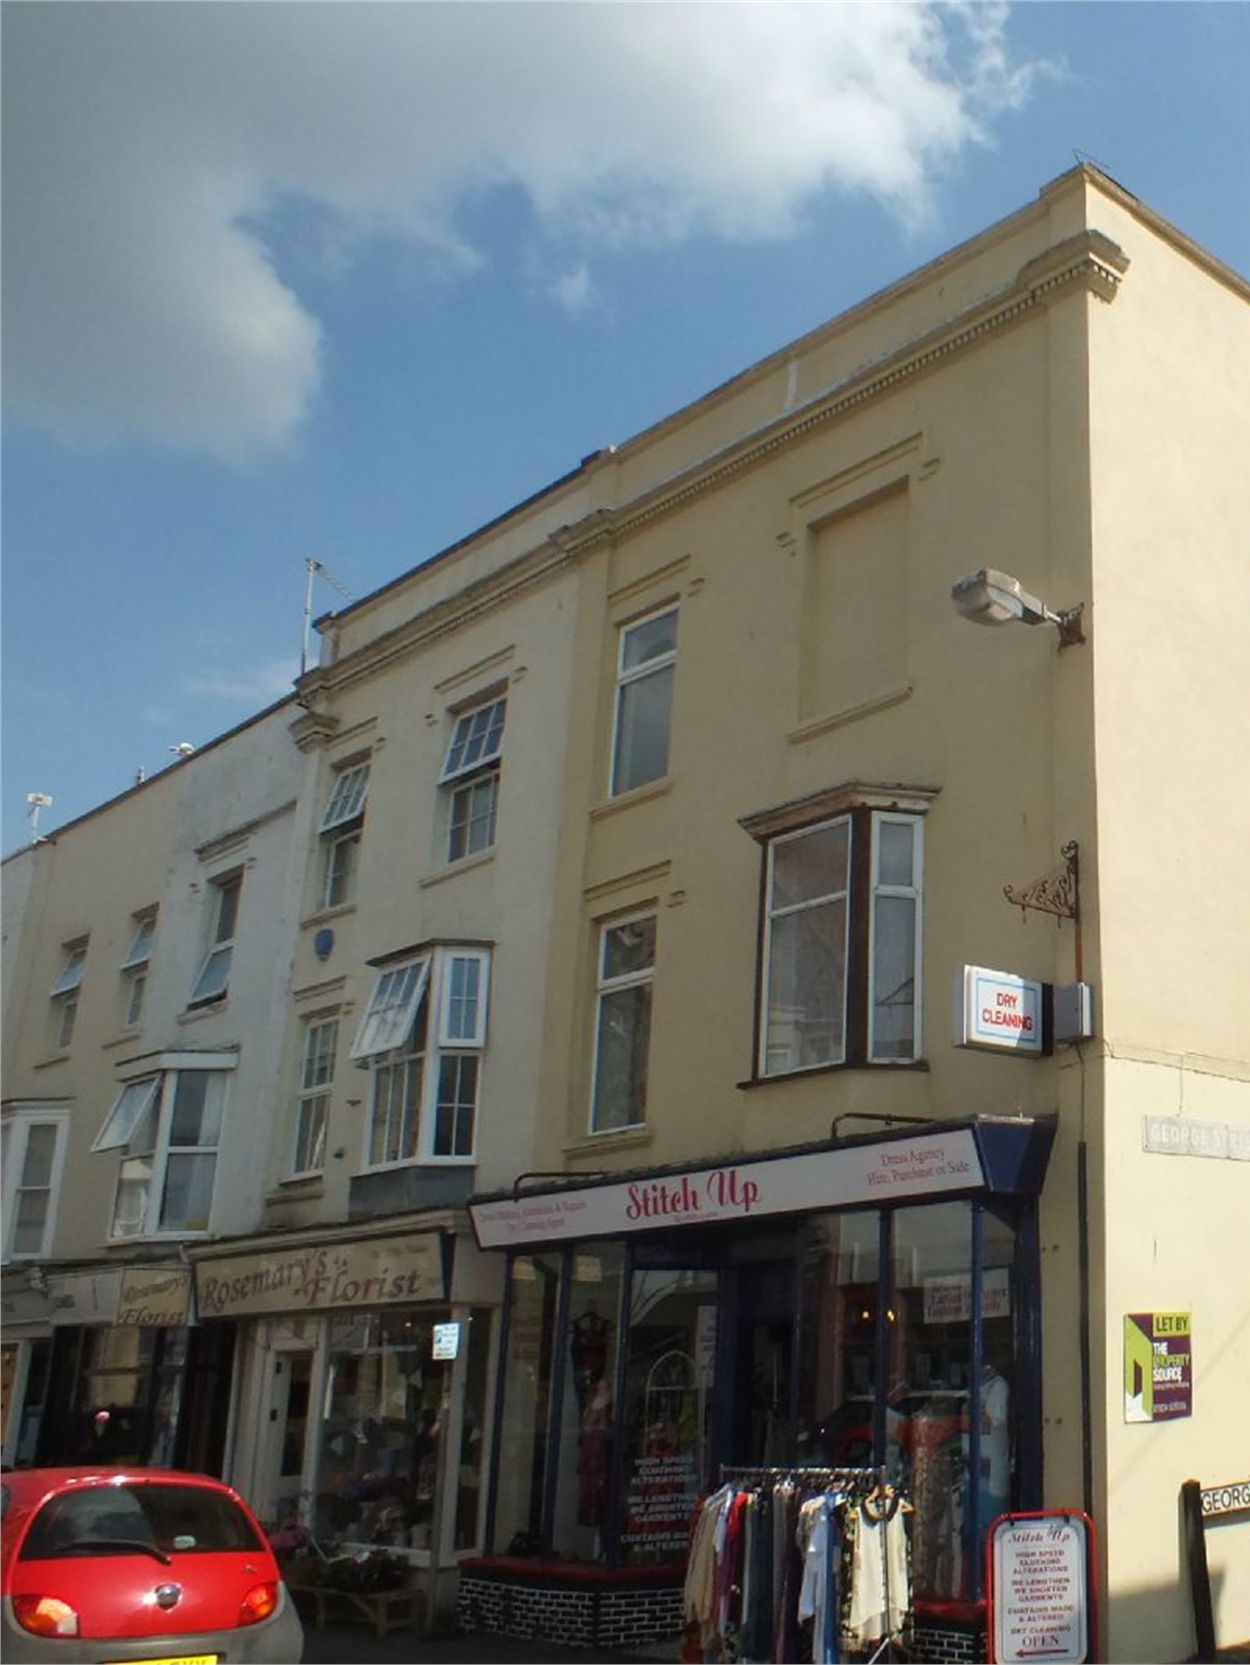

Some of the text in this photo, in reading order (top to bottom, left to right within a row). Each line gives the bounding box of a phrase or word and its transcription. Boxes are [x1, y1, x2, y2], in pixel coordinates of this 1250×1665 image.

[996, 992, 1018, 1008] DRY
[982, 1008, 1033, 1031] CLEANING
[1150, 1123, 1208, 1147] GEORGE
[910, 1148, 945, 1164] Agency
[626, 1177, 701, 1220] Stitch
[706, 1169, 762, 1213] Up
[199, 1249, 328, 1311] Rosemary's
[298, 1267, 423, 1306] Florist
[1155, 1316, 1188, 1331] LET BY
[1153, 1342, 1168, 1355] THE
[1008, 1532, 1043, 1544] Stitch
[1039, 1549, 1065, 1557] SPEED
[1013, 1566, 1068, 1575] ALTERATIONS
[1022, 1635, 1060, 1648] OPEN
